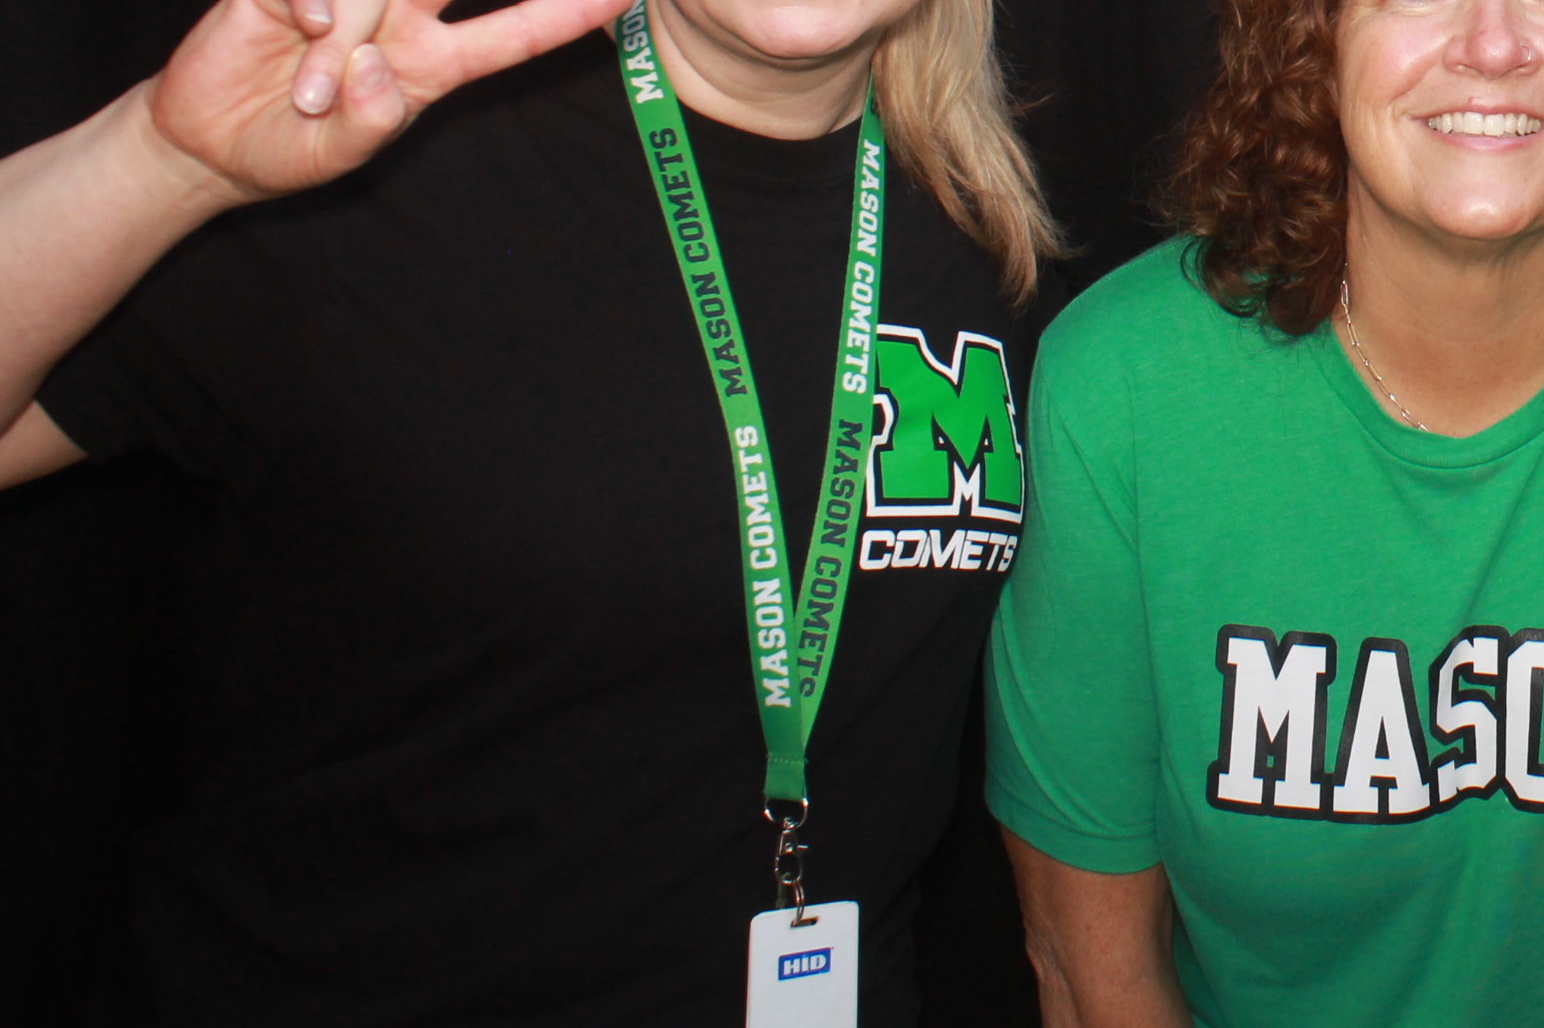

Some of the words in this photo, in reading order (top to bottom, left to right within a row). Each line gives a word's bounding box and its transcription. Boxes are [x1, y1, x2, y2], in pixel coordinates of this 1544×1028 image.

[650, 127, 710, 264] COMETS
[856, 139, 881, 257] MASON
[692, 271, 748, 397] MASON
[842, 260, 876, 395] COMETS
[820, 418, 864, 549] MASON
[866, 324, 1026, 524] M
[734, 425, 778, 570] COMETS
[858, 528, 1018, 572] COMETS
[752, 578, 792, 708] MASON
[797, 555, 843, 698] COMETS
[781, 952, 829, 977] HID
